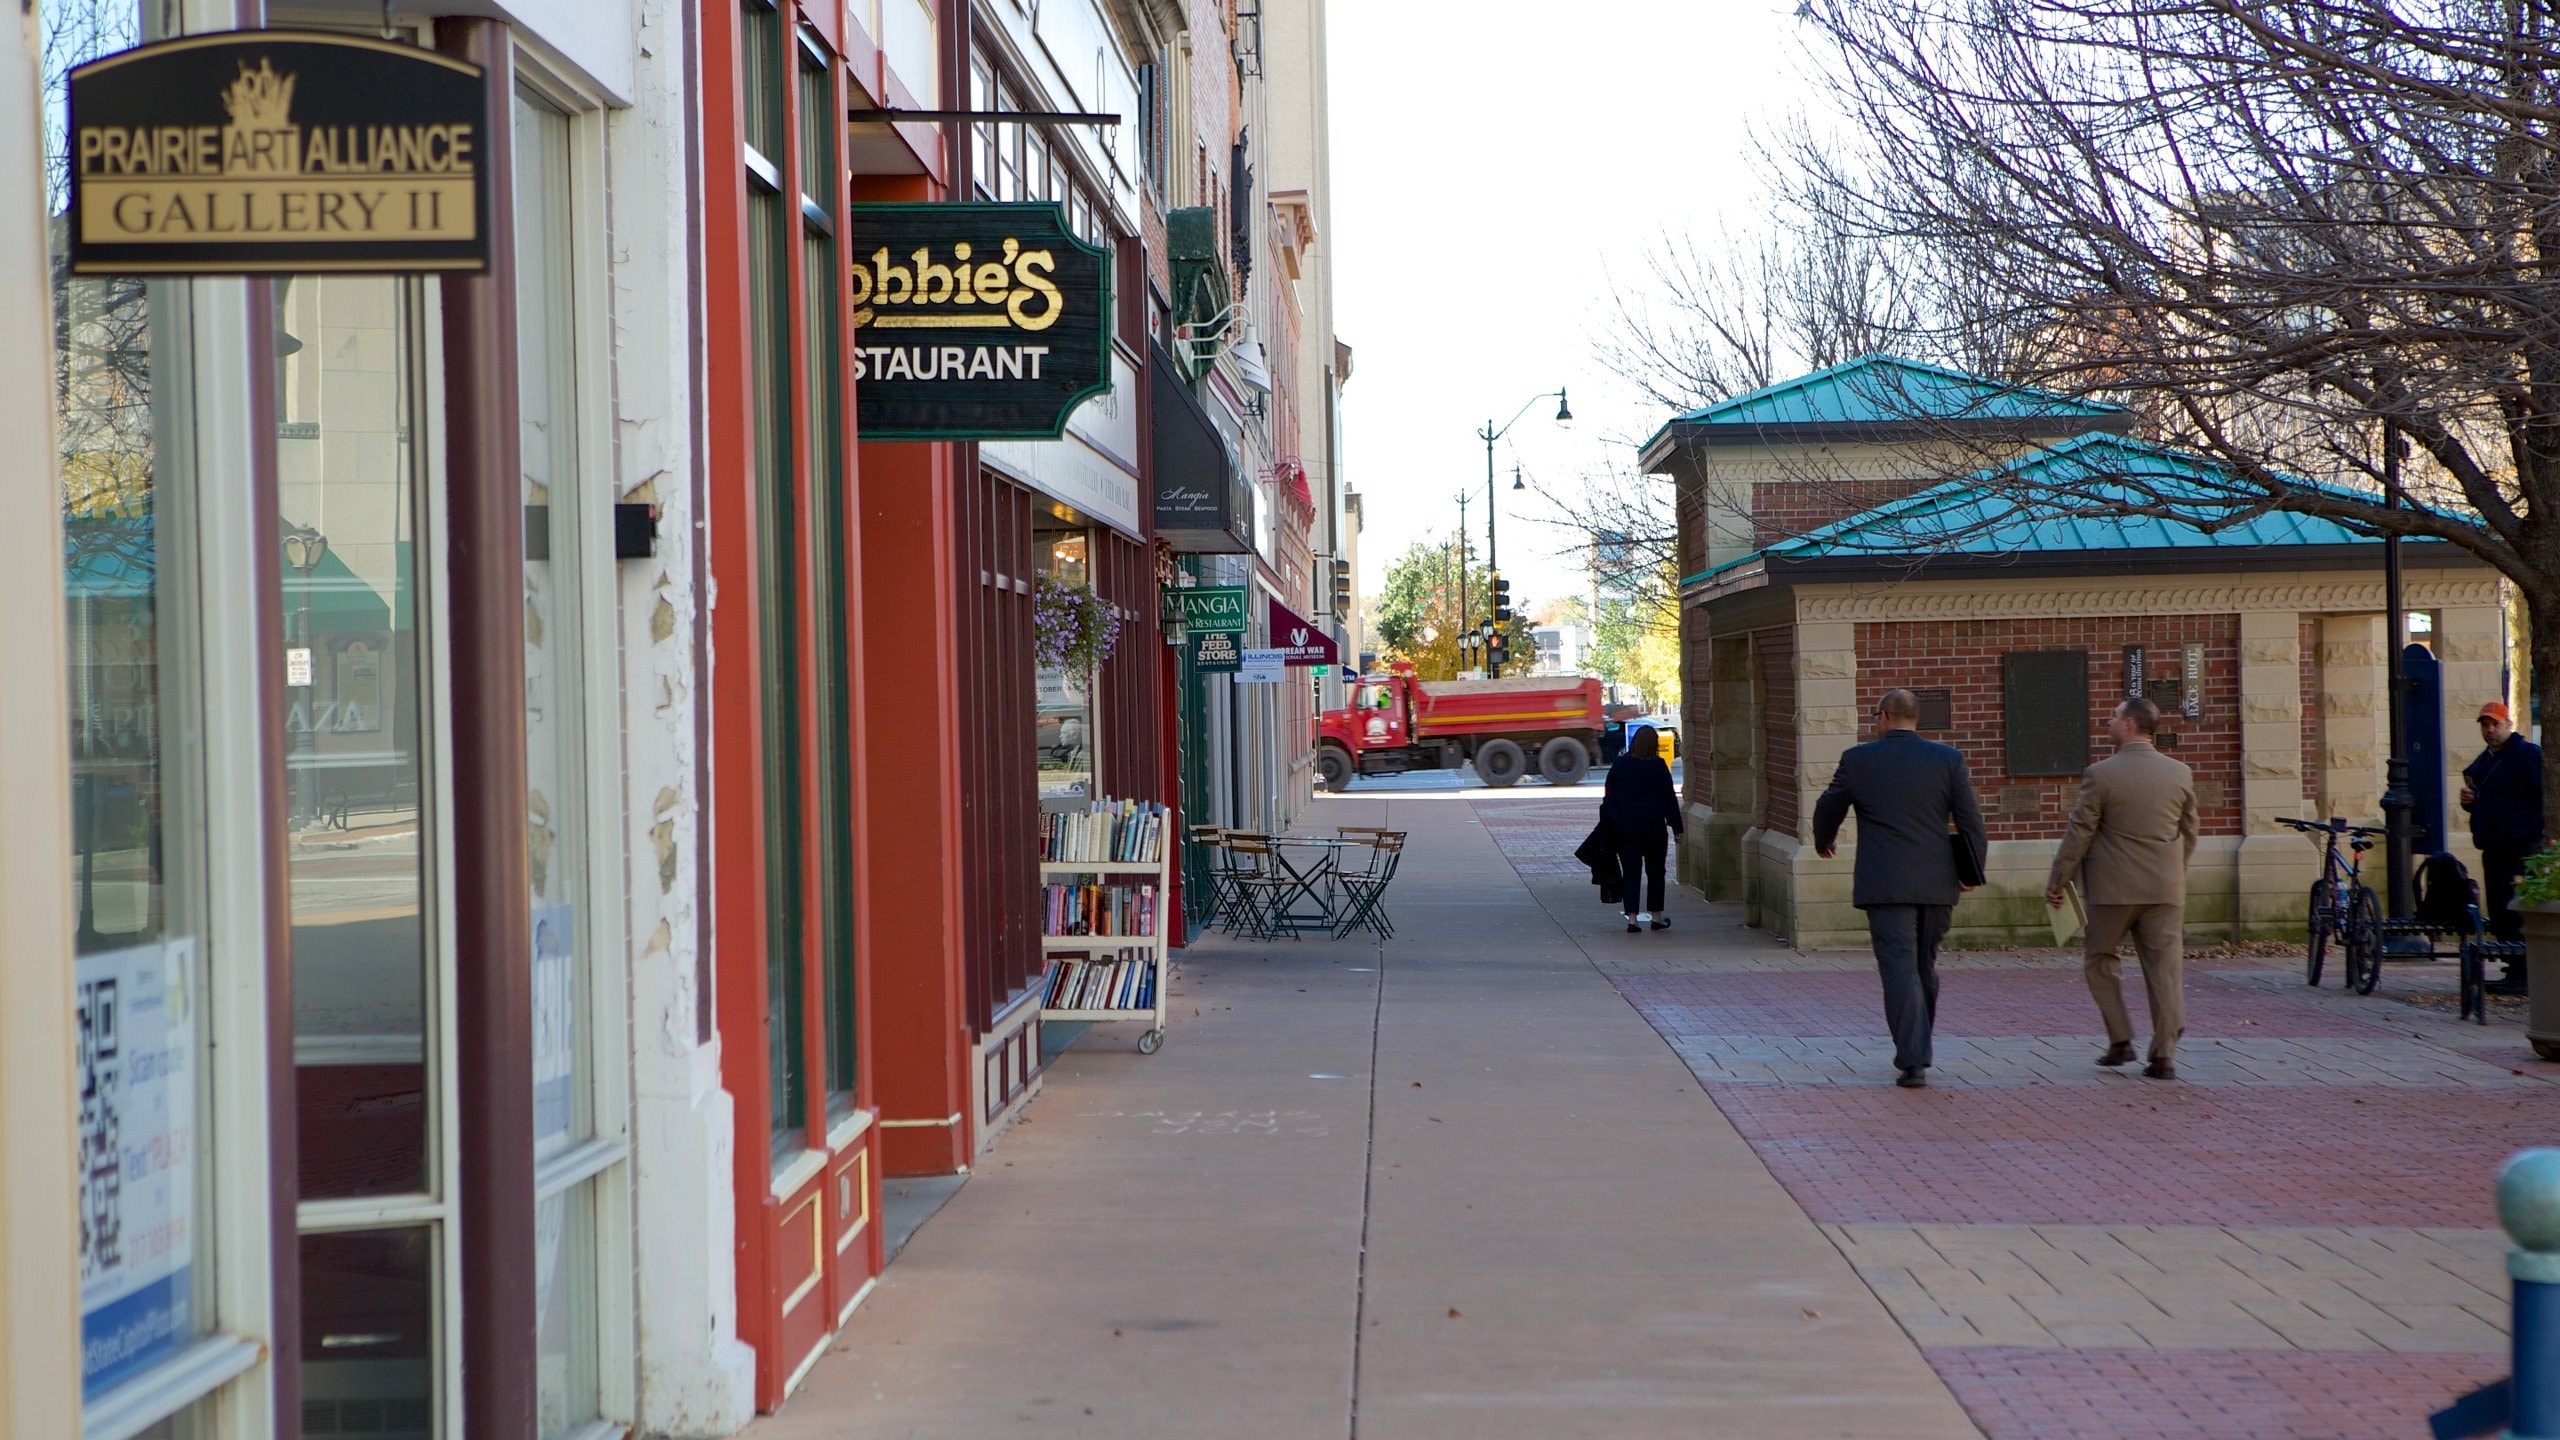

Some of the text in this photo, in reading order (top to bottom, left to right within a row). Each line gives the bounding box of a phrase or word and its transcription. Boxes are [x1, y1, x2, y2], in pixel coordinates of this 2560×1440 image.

[80, 125, 473, 174] PRAIRIE ART ALLIANCE
[112, 190, 443, 234] GALLERY II
[1161, 486, 1209, 507] Mangia
[1166, 595, 1240, 614] MANGIA
[1201, 640, 1232, 650] FEED
[1307, 646, 1325, 654] WAR
[1198, 650, 1237, 661] STORE
[2188, 685, 2199, 716] RACE
